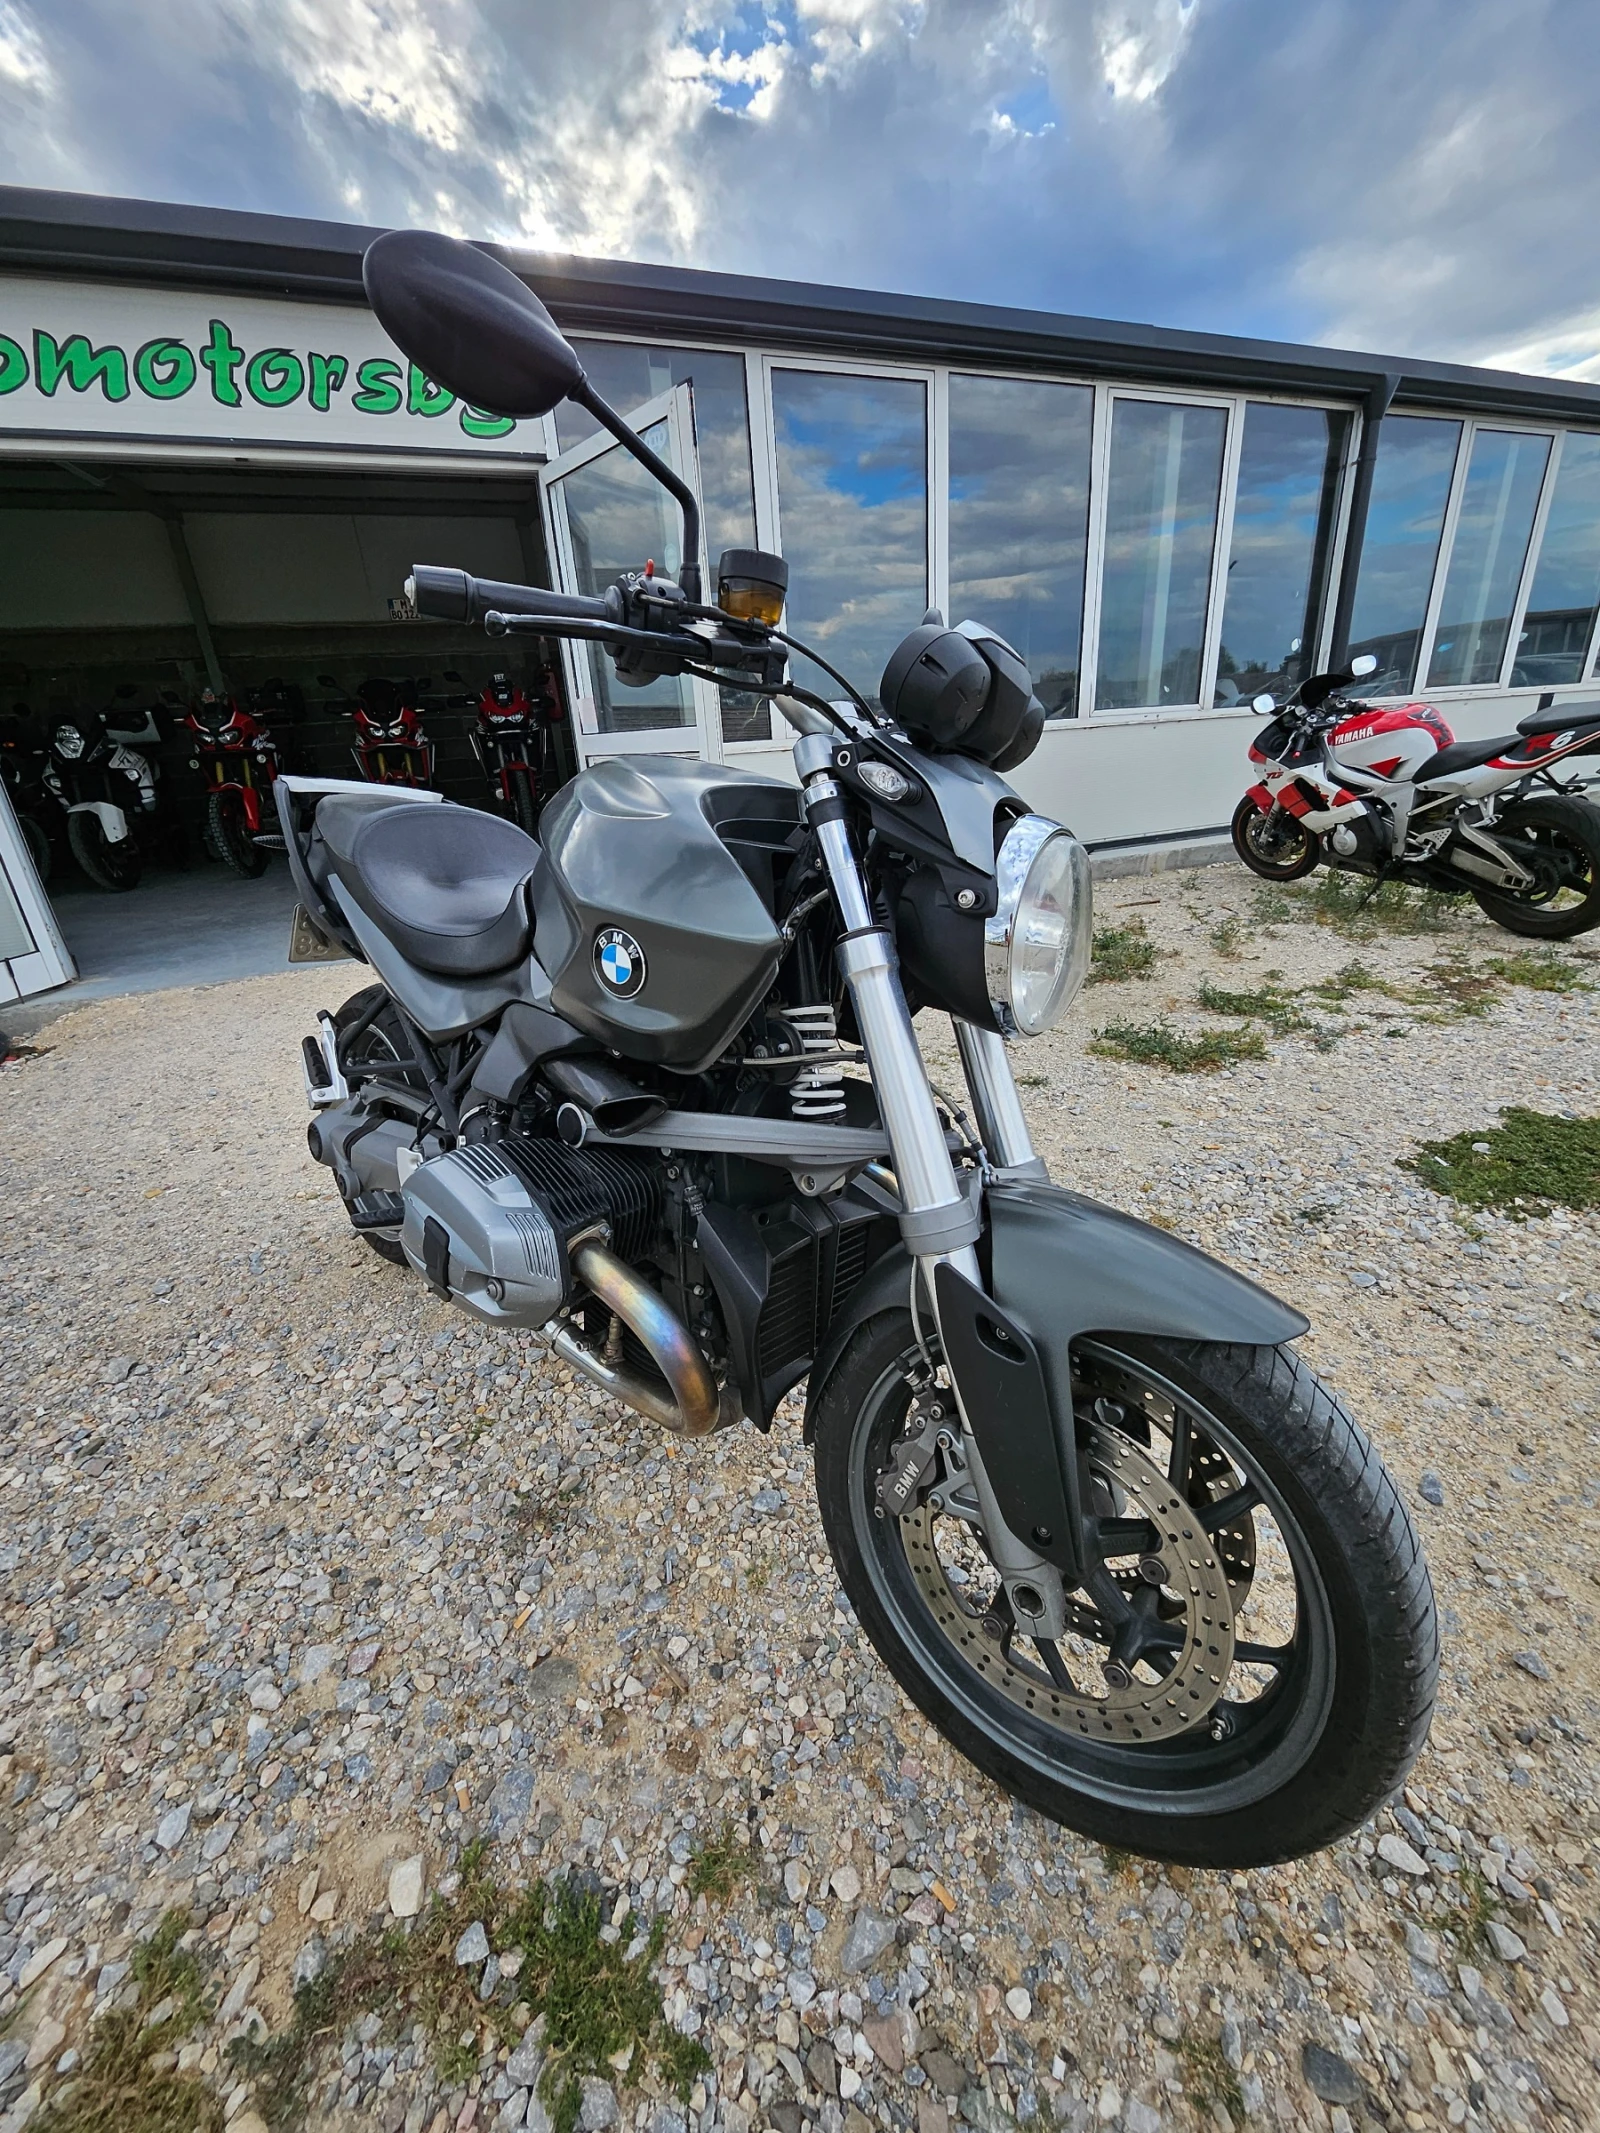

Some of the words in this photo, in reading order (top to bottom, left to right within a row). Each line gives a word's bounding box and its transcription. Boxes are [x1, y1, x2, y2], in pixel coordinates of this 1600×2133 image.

[1334, 726, 1374, 746] YAMAHA
[598, 931, 639, 960] BMW
[893, 1459, 920, 1499] BMW
